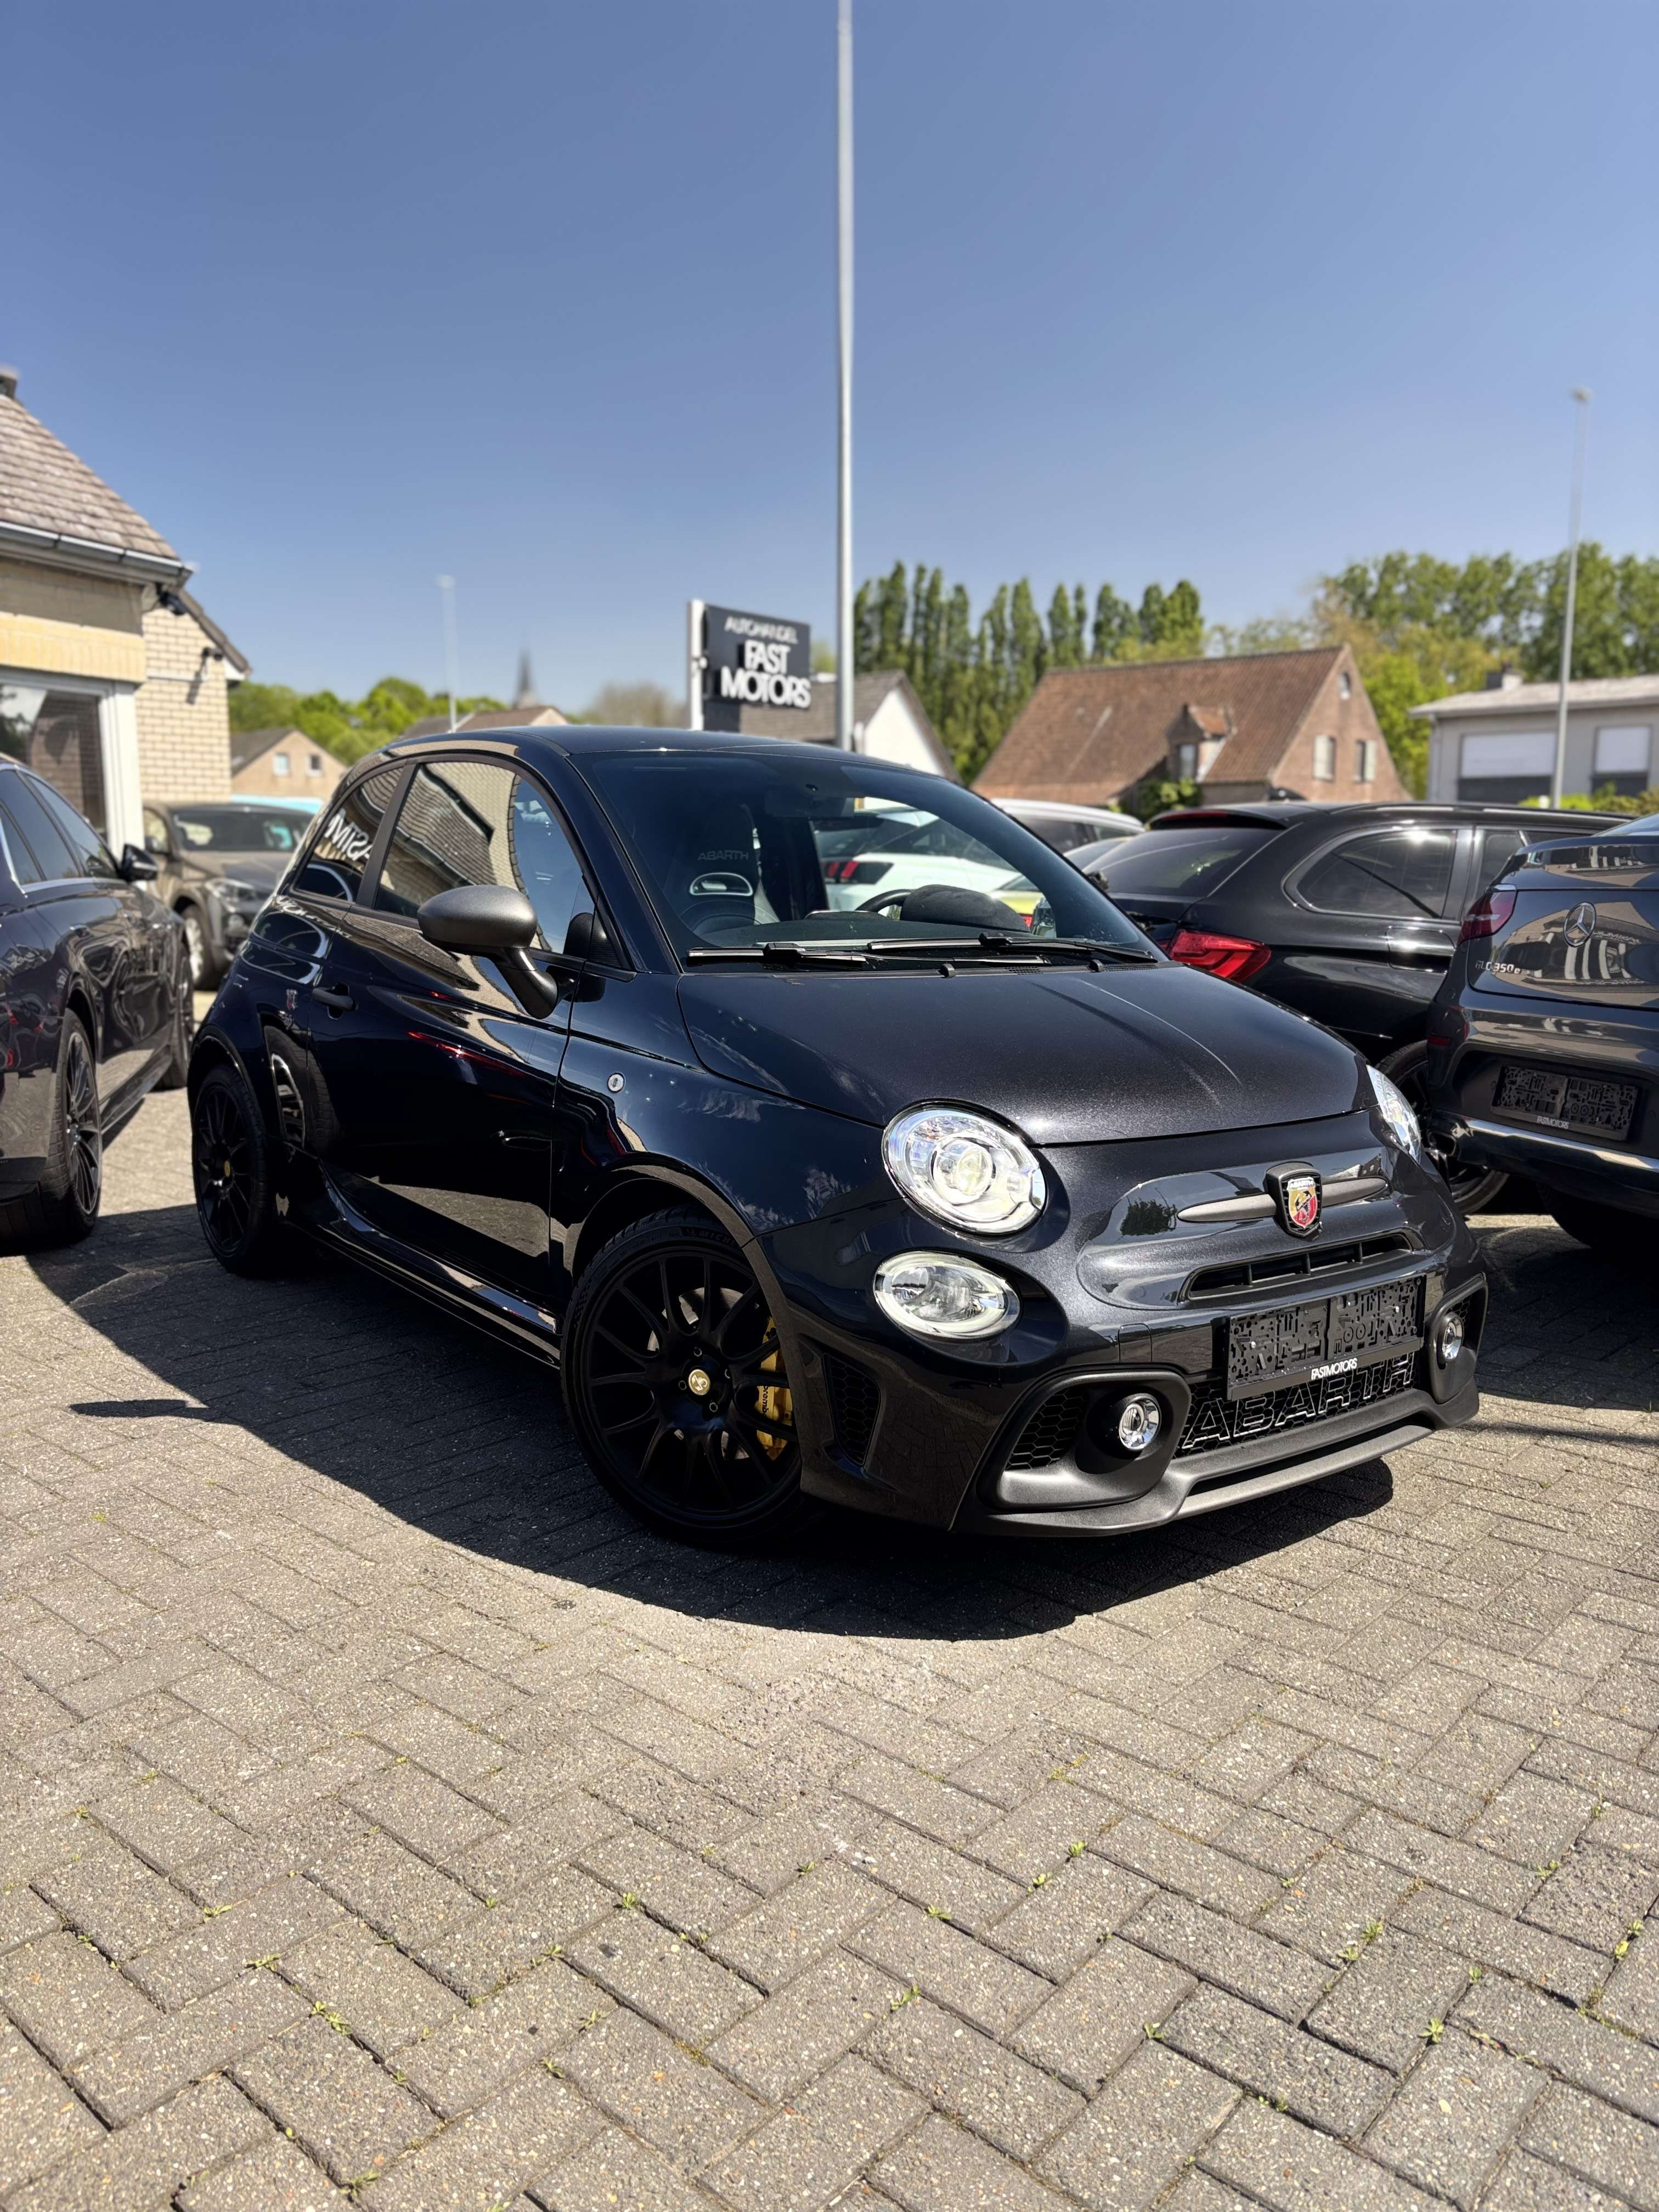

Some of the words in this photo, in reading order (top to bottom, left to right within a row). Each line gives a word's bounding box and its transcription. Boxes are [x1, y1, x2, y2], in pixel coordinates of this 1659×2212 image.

[744, 639, 791, 674] FAST
[720, 665, 811, 708] MOTORS
[697, 850, 749, 861] ABARTH
[1311, 1357, 1358, 1380] FASTMOTORS
[762, 1384, 770, 1414] bremb
